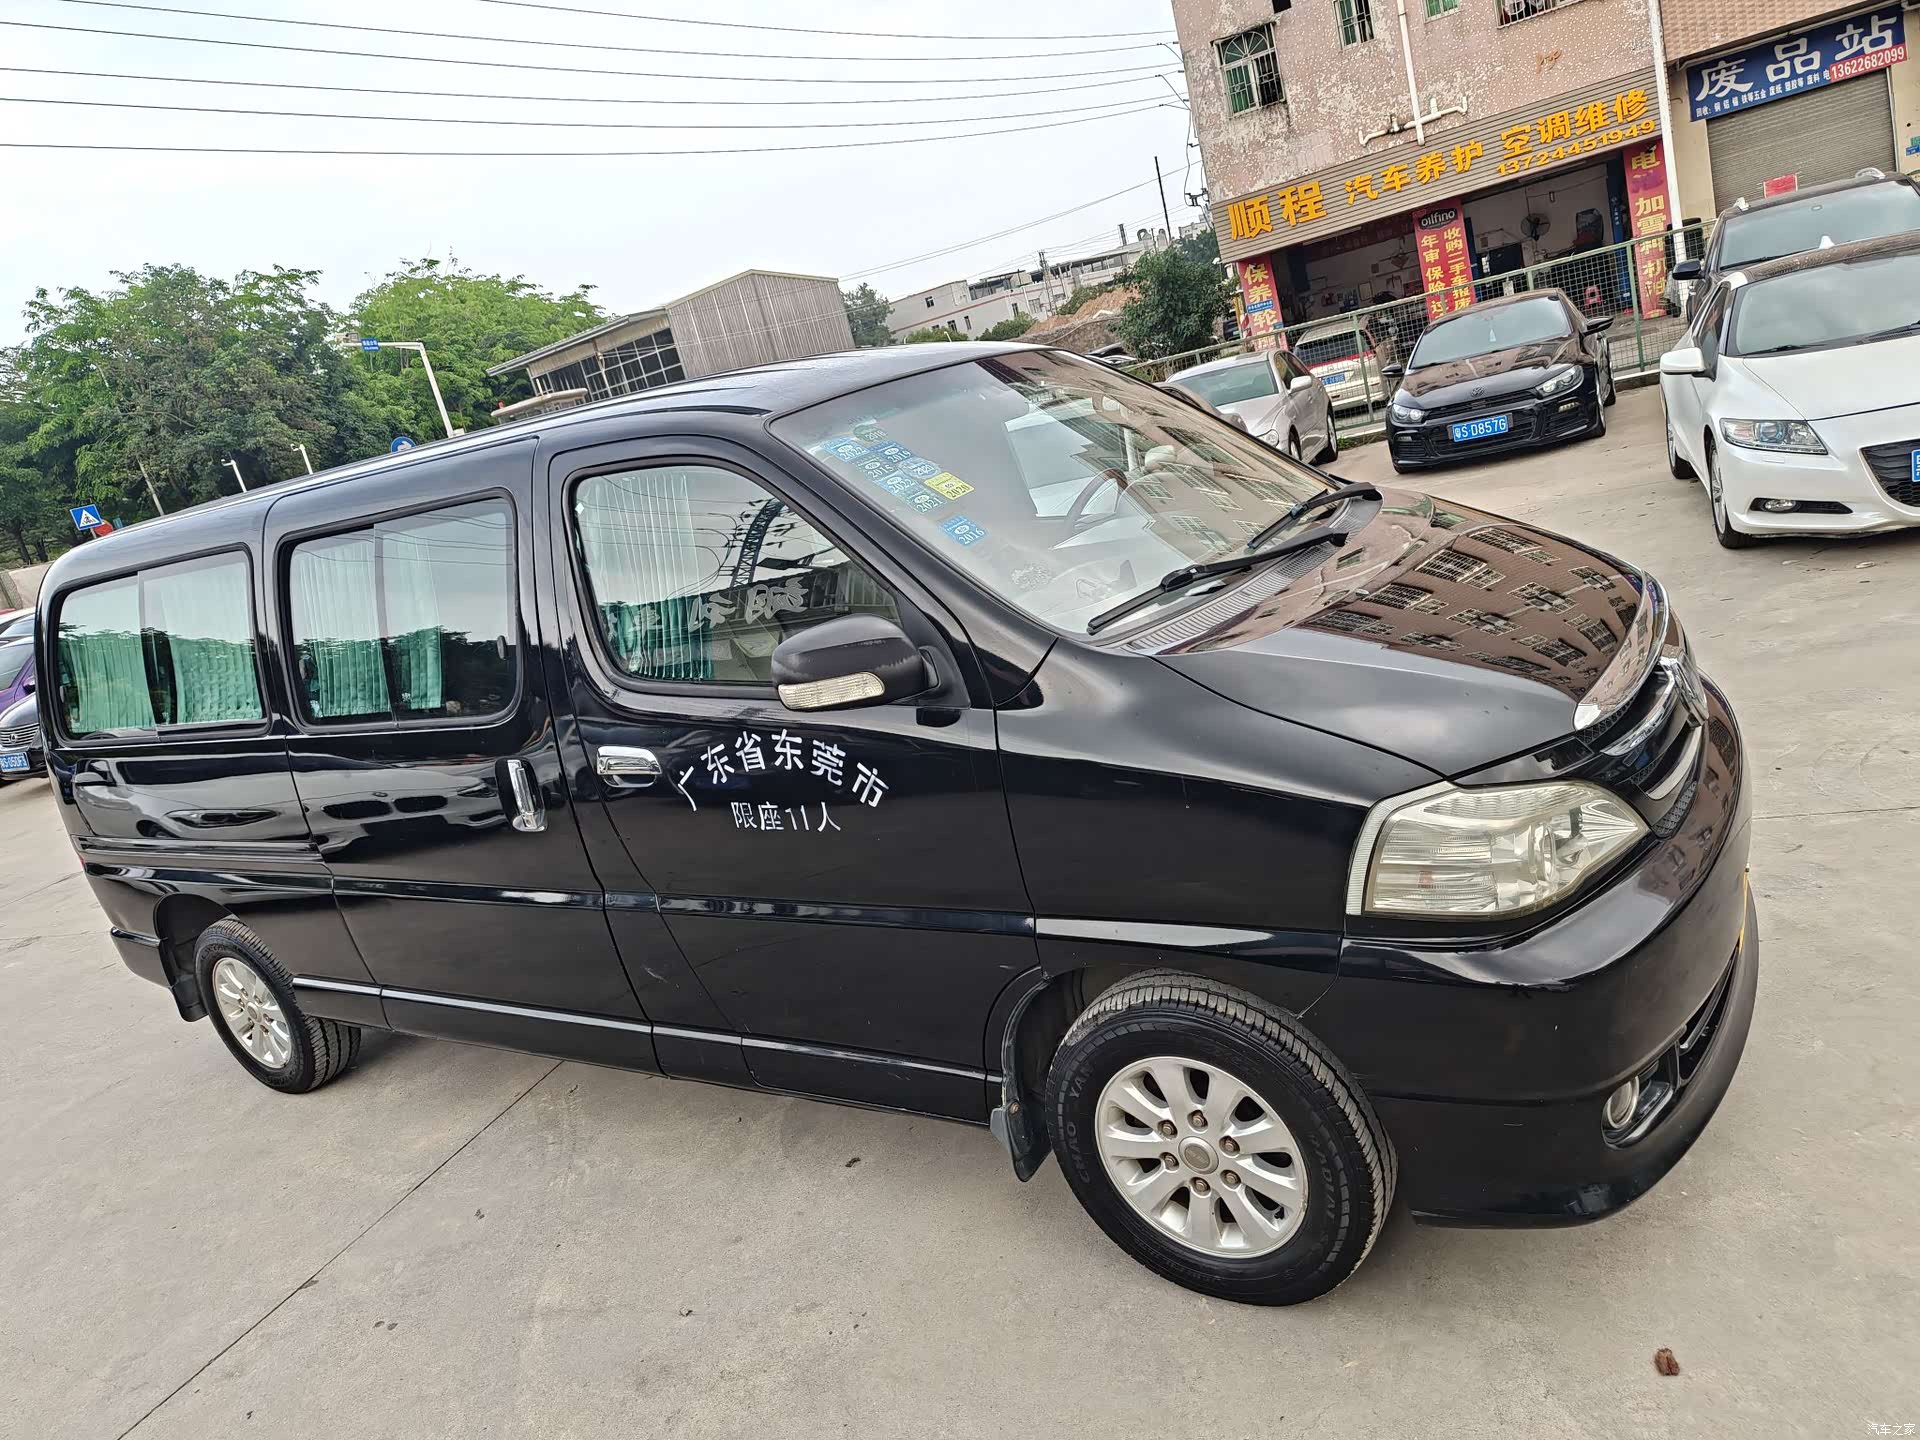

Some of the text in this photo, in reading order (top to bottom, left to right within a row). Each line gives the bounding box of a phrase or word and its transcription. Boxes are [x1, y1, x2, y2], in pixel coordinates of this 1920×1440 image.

[1696, 15, 1897, 101] 废品站
[1831, 47, 1904, 79] 13622682099
[1496, 119, 1655, 177] 13724451949
[1226, 181, 1328, 240] 顺程
[1344, 139, 1484, 205] 汽车养护
[1500, 88, 1649, 160] 空调维修
[1421, 208, 1456, 227] oilfino
[1421, 234, 1447, 319] 年审保险过
[840, 446, 866, 459] 2022
[887, 450, 911, 463] 2019
[868, 464, 893, 477] 2015
[889, 478, 915, 493] 2022
[946, 483, 970, 498] 2020
[917, 497, 943, 512] 2021
[958, 527, 984, 544] 2016
[678, 729, 889, 811] 广东省东莞市
[731, 801, 841, 832] 限座11人
[1066, 1121, 1091, 1184] CHAO
